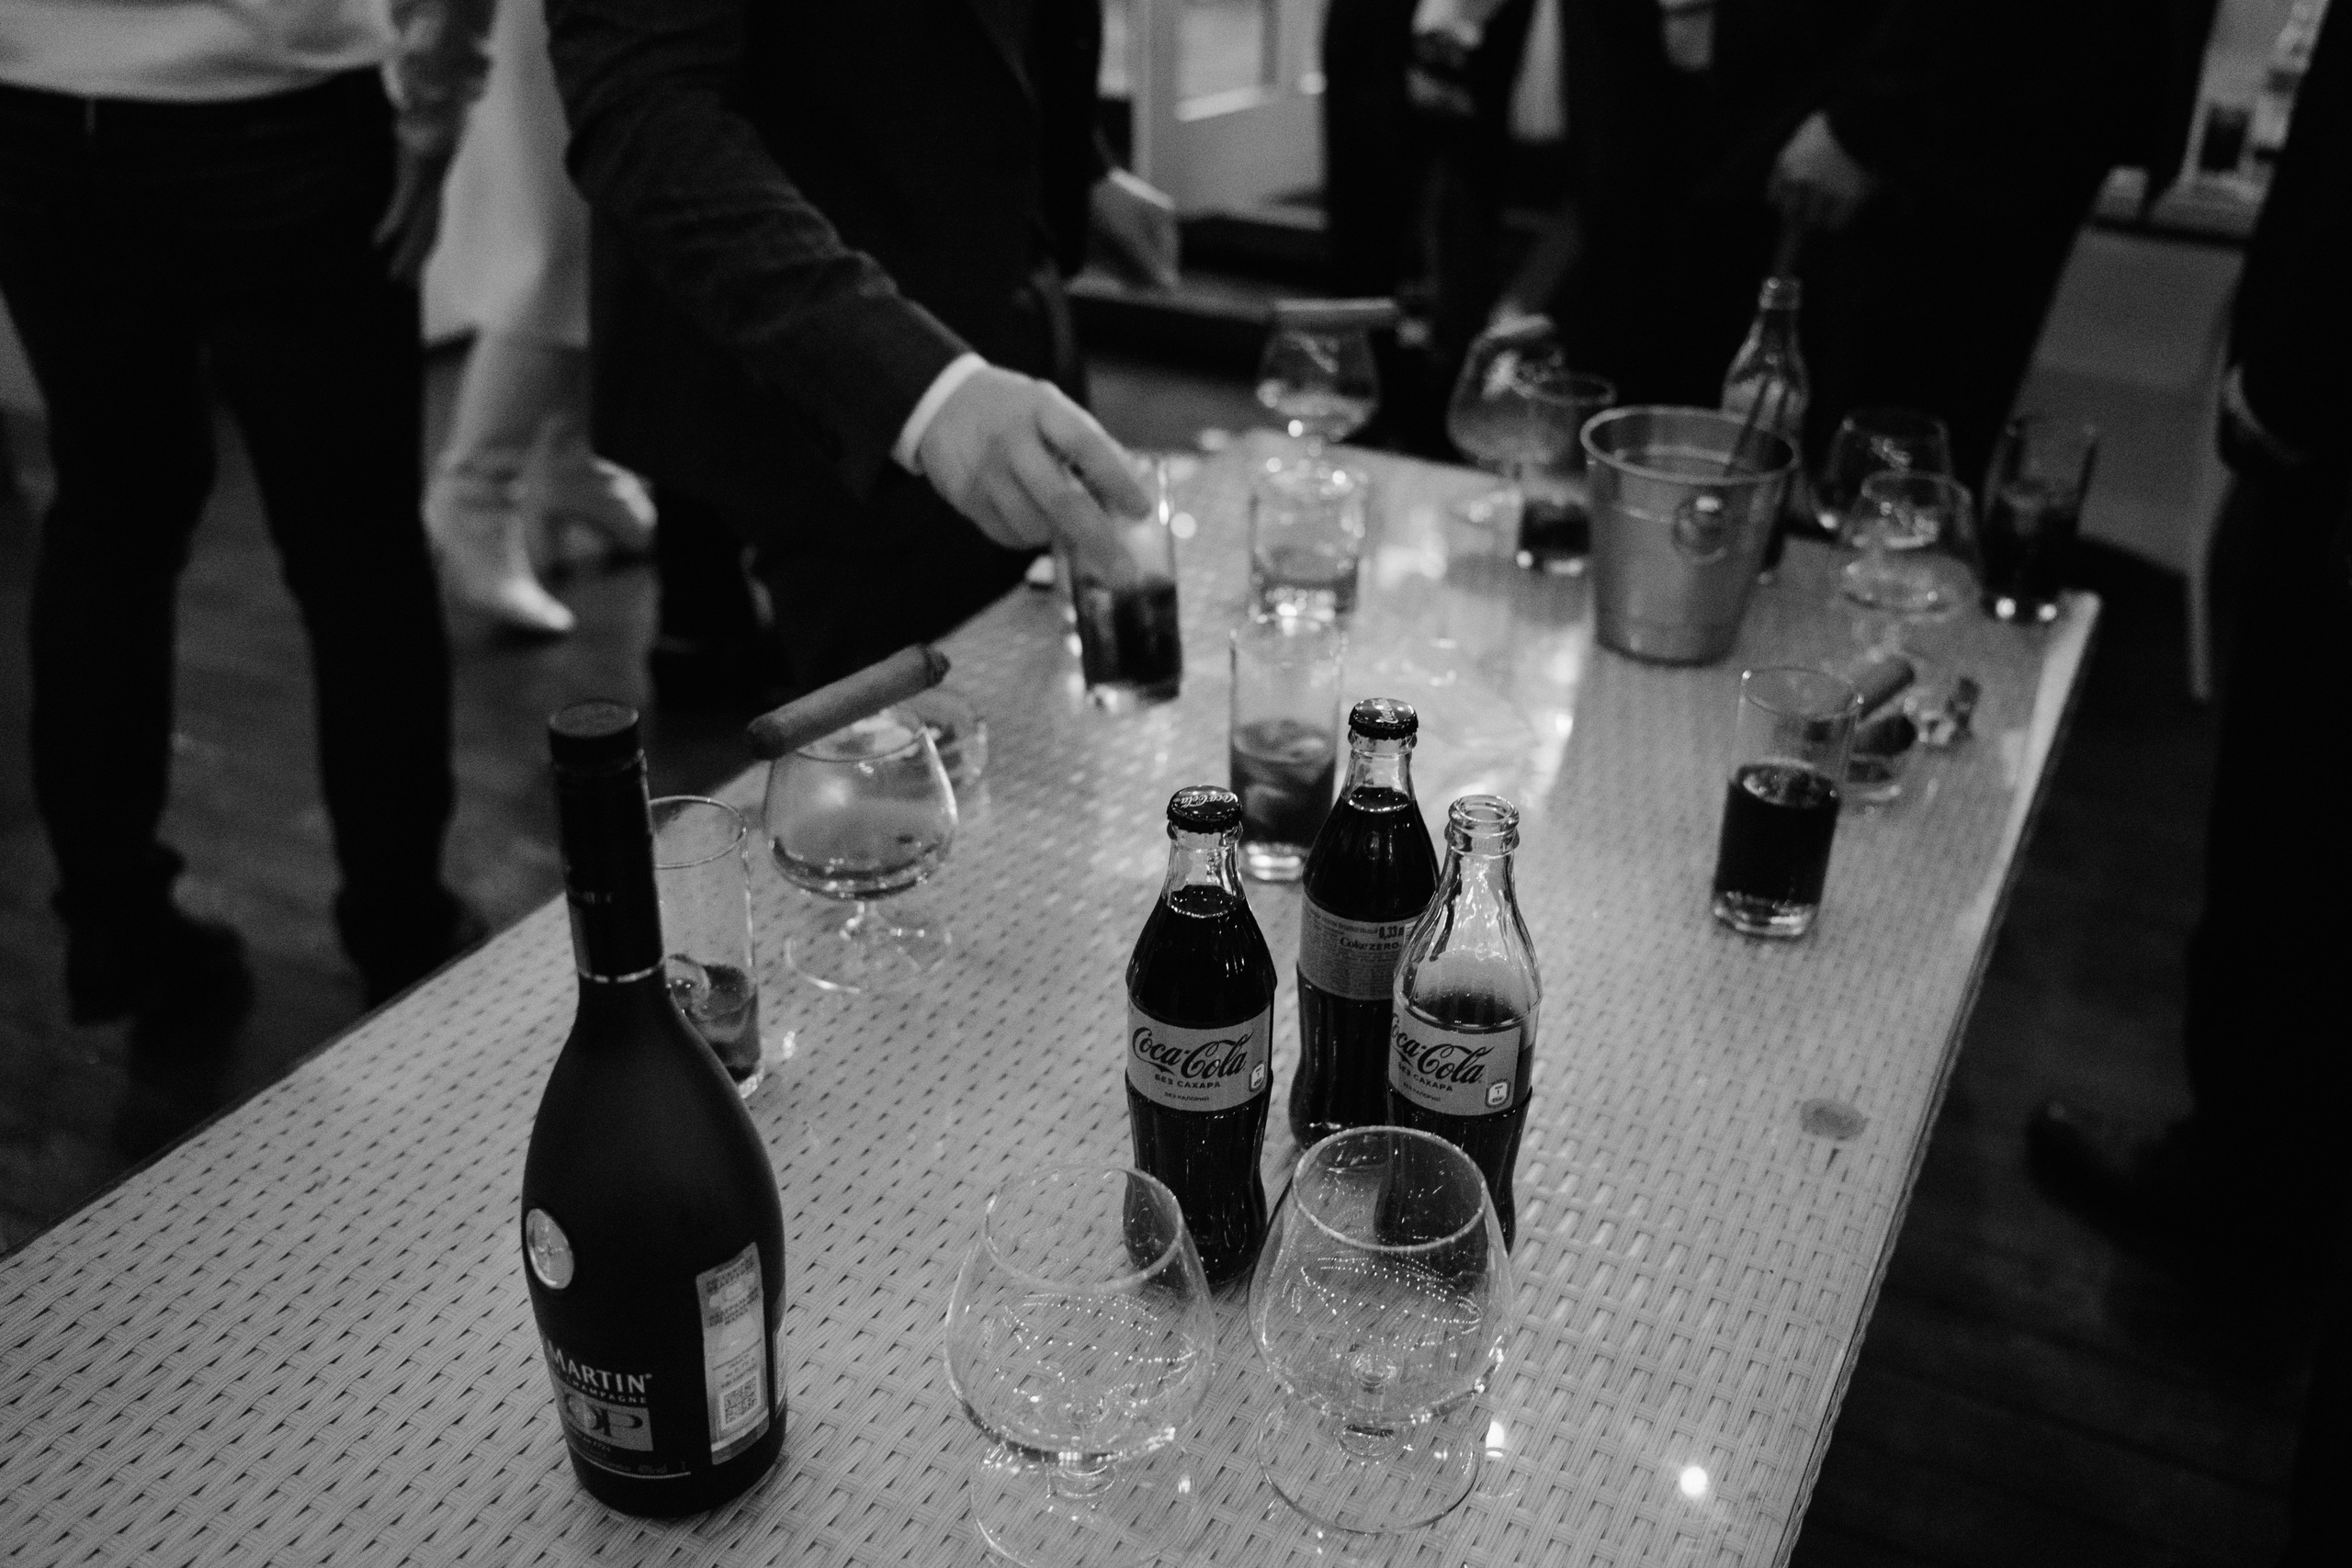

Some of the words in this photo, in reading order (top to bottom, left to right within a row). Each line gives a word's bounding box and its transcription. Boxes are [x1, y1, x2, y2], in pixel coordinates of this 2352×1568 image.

[1379, 926, 1397, 940] 0,33
[1132, 1027, 1253, 1078] Coca-Cola
[1154, 1074, 1173, 1086] БЕЗ
[1177, 1080, 1221, 1089] САХАРА
[1413, 1073, 1453, 1092] САХАРА
[547, 1339, 647, 1394] MARTIN
